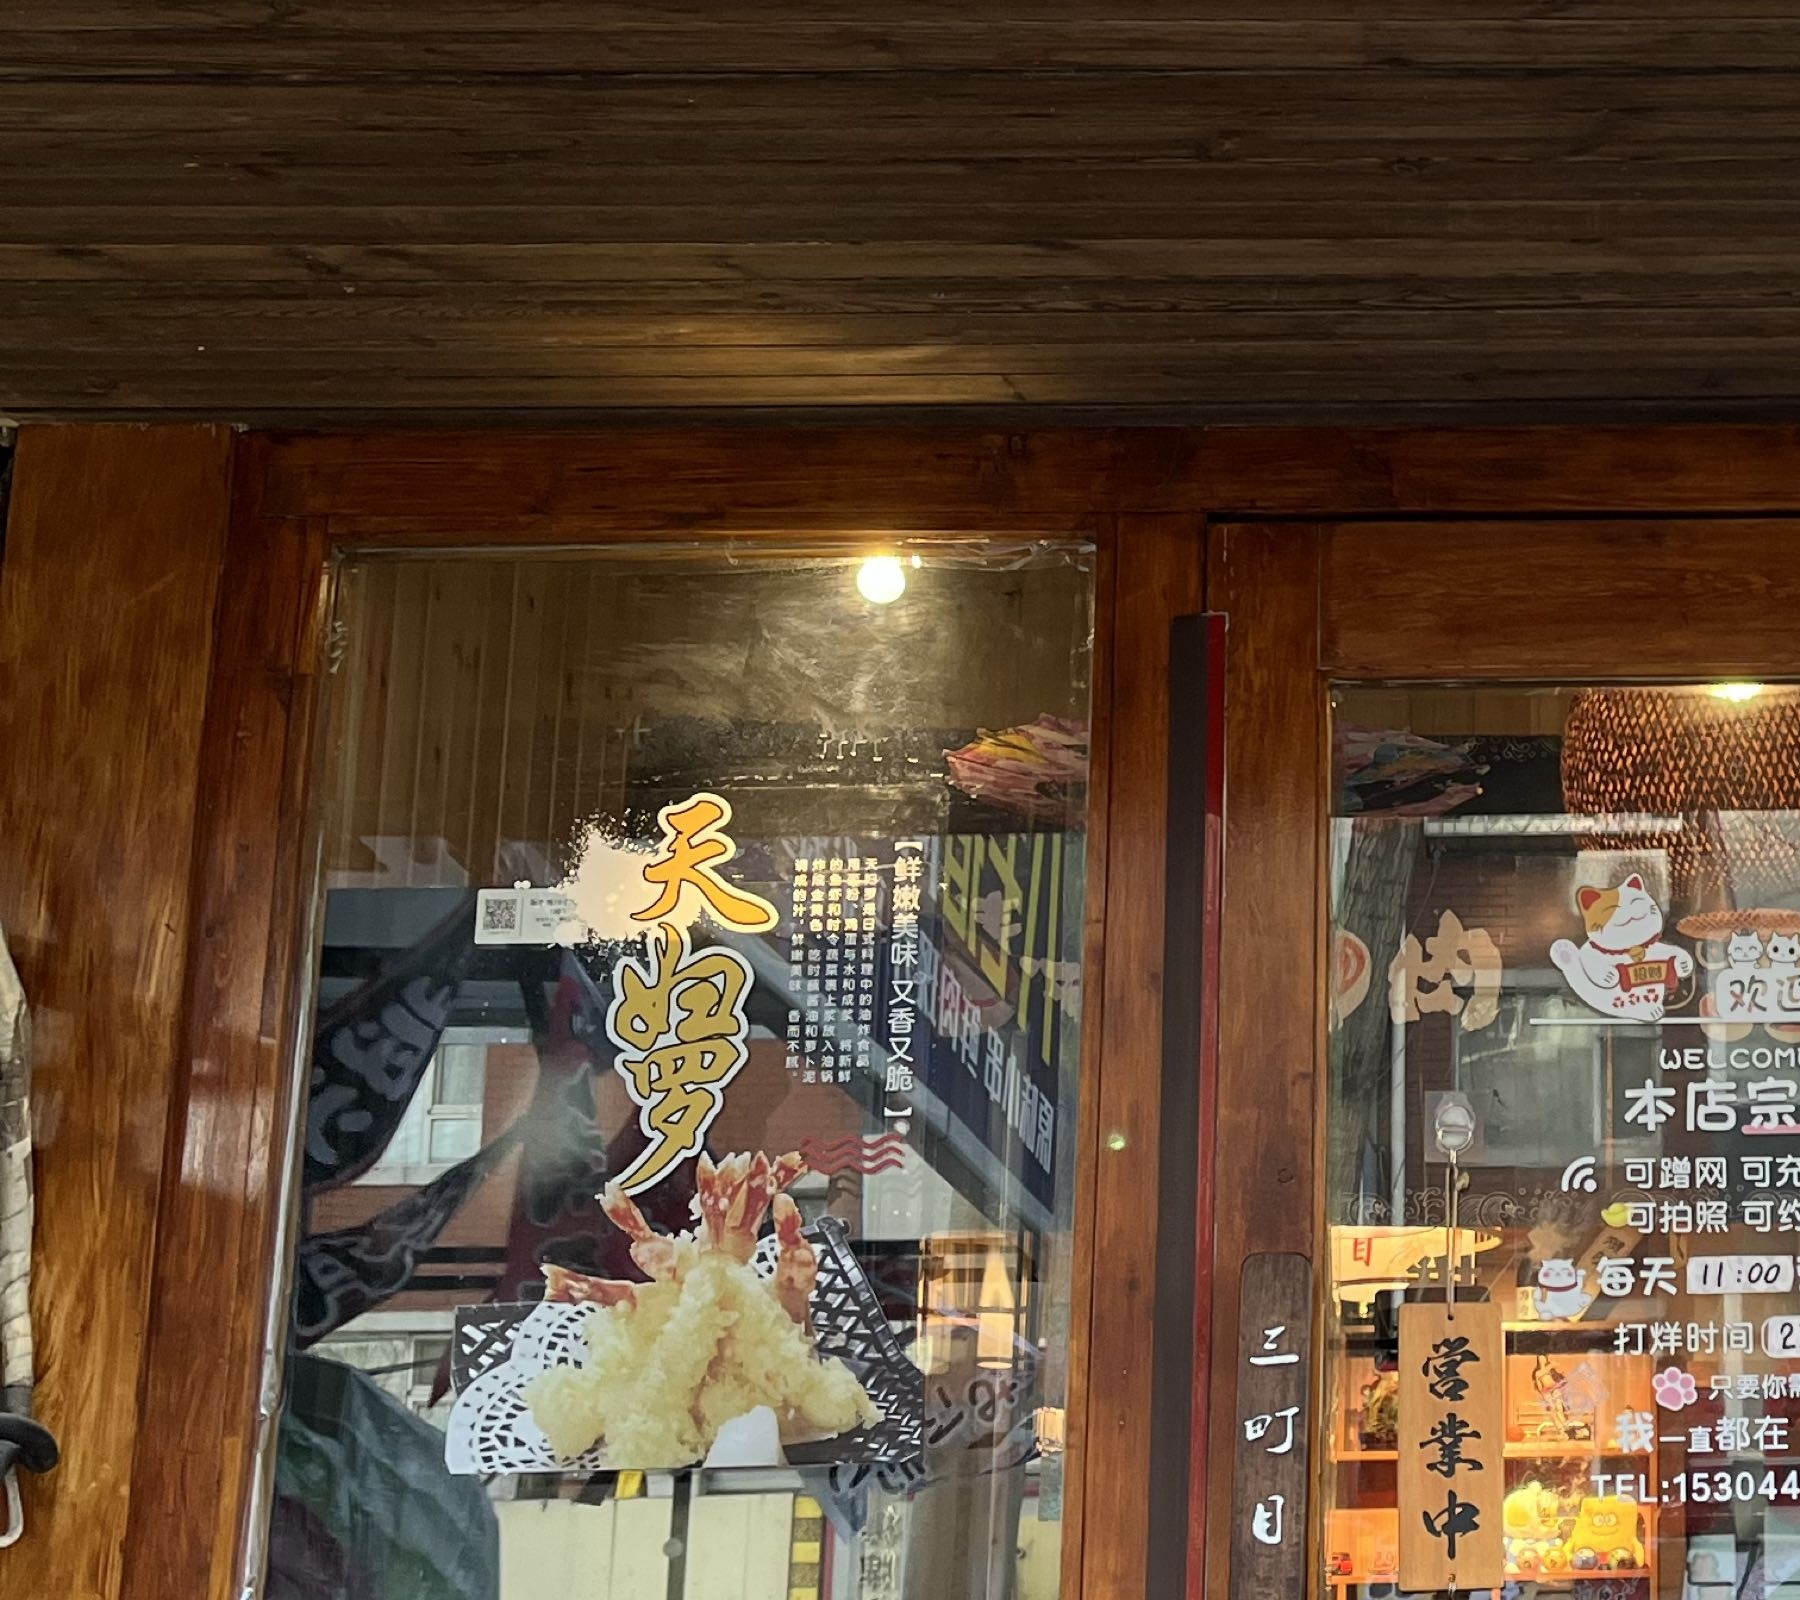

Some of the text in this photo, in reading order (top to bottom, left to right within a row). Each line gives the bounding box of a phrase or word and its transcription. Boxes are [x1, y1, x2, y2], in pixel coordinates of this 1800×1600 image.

[612, 796, 774, 1191] 天妇罗
[1623, 1155, 1729, 1191] 可蹭网
[1625, 1200, 1730, 1234] 可拍照
[1597, 1255, 1678, 1298] 每天
[1701, 1261, 1782, 1288] 11:00
[1613, 1320, 1755, 1357] 打烊时间
[1243, 1325, 1301, 1546] 三町目
[1614, 1408, 1790, 1454] 我一直都在
